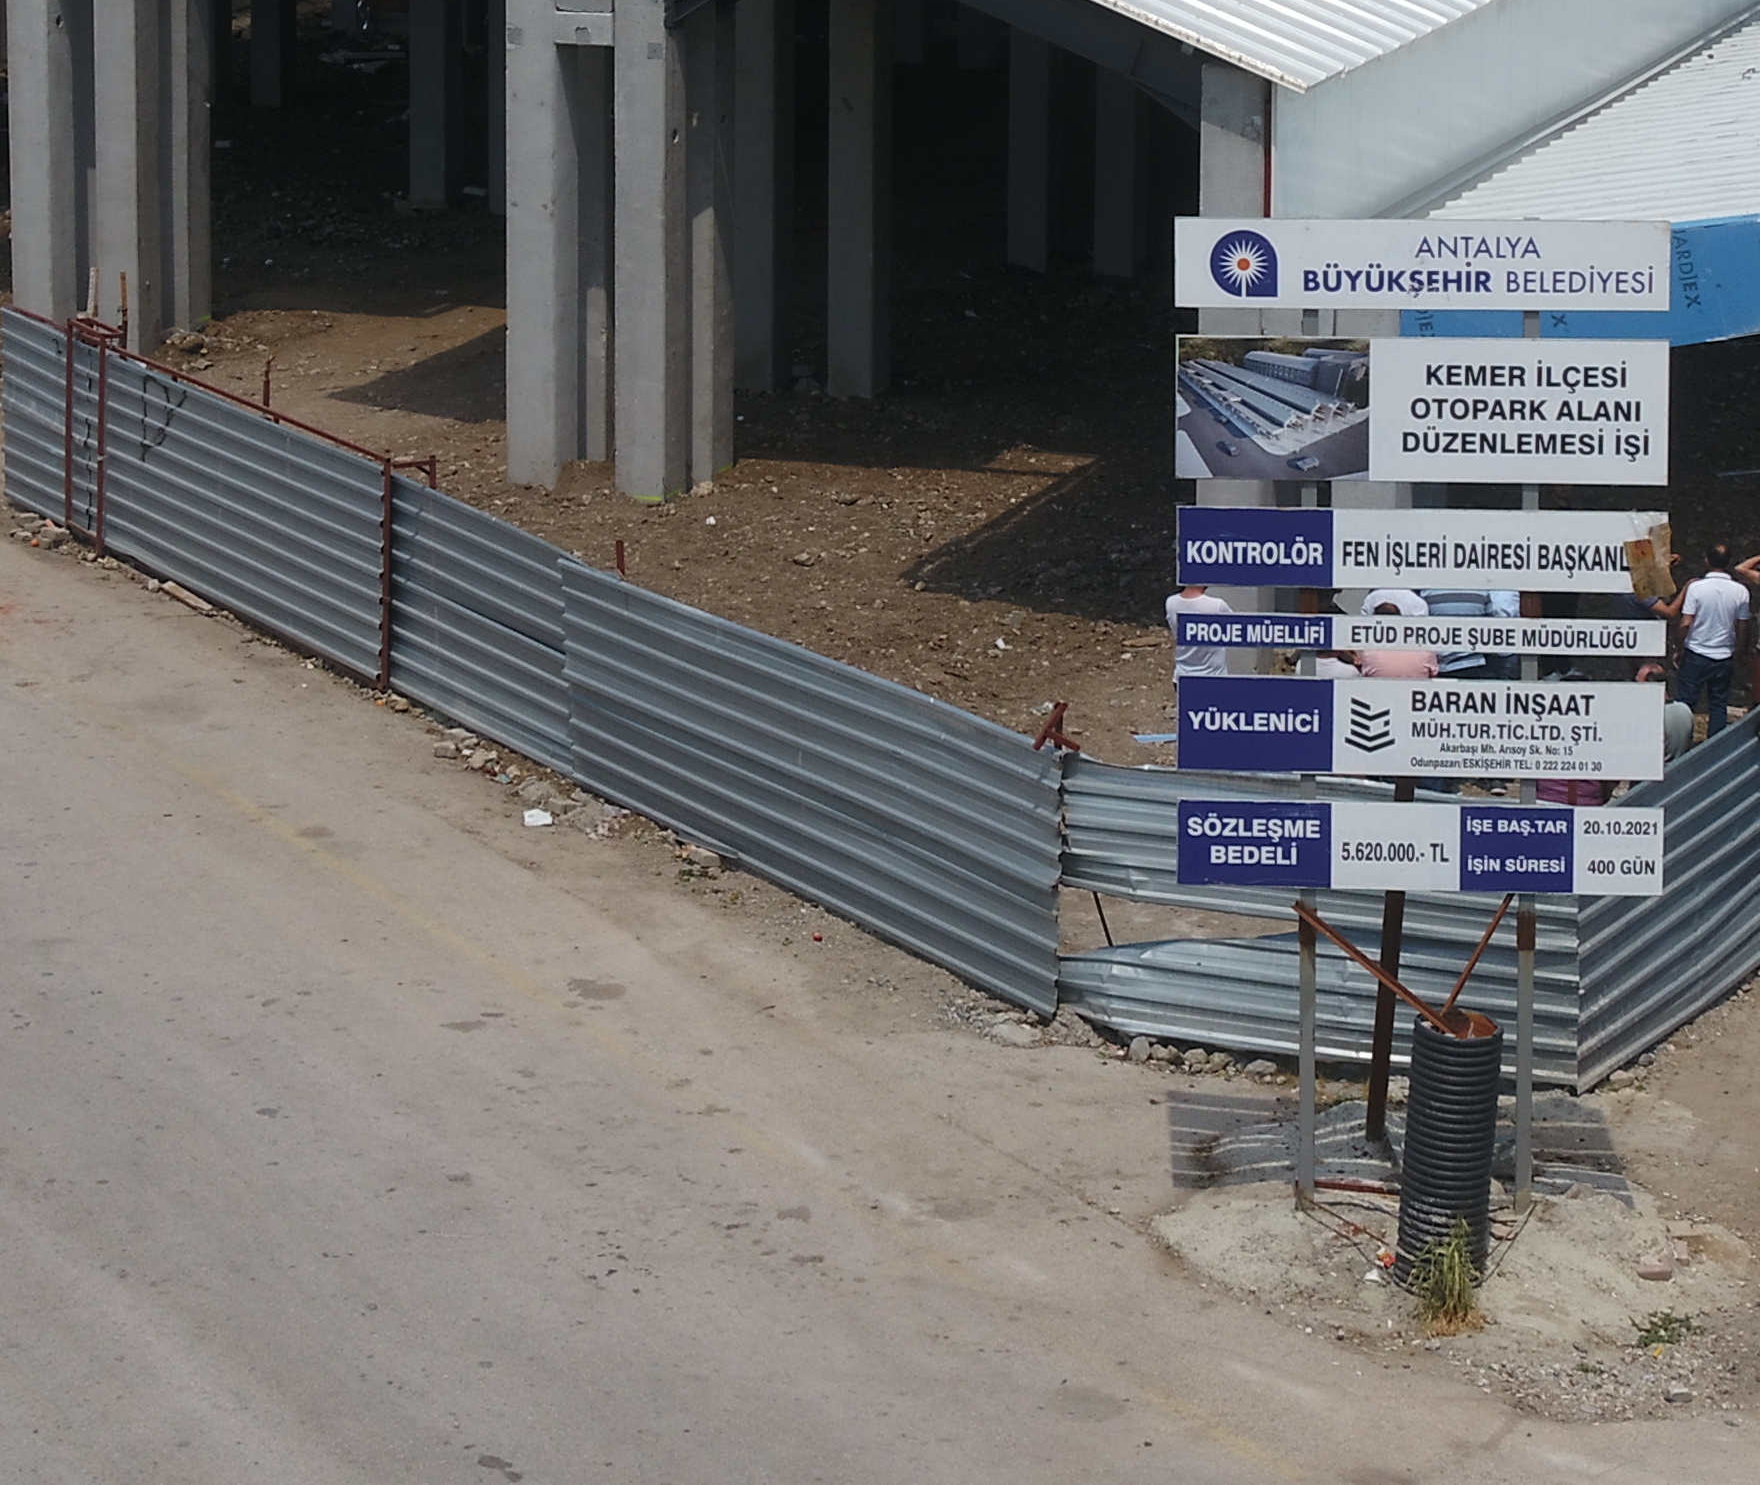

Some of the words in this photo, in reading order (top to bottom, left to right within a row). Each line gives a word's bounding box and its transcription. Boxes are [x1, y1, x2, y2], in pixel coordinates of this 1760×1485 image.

[1415, 235, 1542, 260] ANTALYA
[1302, 262, 1493, 299] BÜYÜKŞEHİR
[1505, 265, 1656, 295] BELEDİYESİ
[1425, 363, 1527, 388] KEMER
[1536, 359, 1629, 395] İLÇESİ
[1410, 398, 1548, 422] OTOPARK
[1555, 400, 1642, 423] ALANI
[1402, 426, 1605, 457] DÜZENLEMESİ
[1614, 432, 1651, 463] İŞİ
[1186, 535, 1324, 567] KONTROLÖR
[1342, 542, 1380, 568] FEN
[1385, 534, 1448, 576] İŞLERİ
[1453, 536, 1532, 571] DAİRESİ
[1538, 543, 1632, 579] BAŞKANL
[1186, 622, 1242, 643] PROJE
[1247, 620, 1325, 646] MÜELLİFİ
[1351, 619, 1397, 645] ETÜD
[1403, 626, 1462, 647] PROJE
[1467, 627, 1516, 652] ŞUBE
[1521, 622, 1639, 650] MÜDÜRLÜĞÜ
[1410, 690, 1497, 716] BARAN
[1505, 686, 1596, 723] İNŞAAT
[1188, 706, 1321, 734] YÜKLENİCİ
[1411, 718, 1565, 742] MÜH.TUR.TİC.LTD.
[1571, 721, 1604, 747] ŞTİ.
[1440, 743, 1479, 756] Akarbaşı
[1480, 744, 1497, 755] Mh.
[1529, 745, 1543, 756] Sk.
[1545, 746, 1560, 756] No:
[1563, 746, 1574, 756] 15
[1535, 761, 1541, 771] 0
[1542, 761, 1559, 771] 222
[1560, 761, 1577, 772] 224
[1578, 761, 1589, 772] 01
[1591, 762, 1602, 772] 30
[1186, 814, 1321, 843] SÖZLEŞME
[1466, 815, 1495, 839] İŞE
[1498, 817, 1568, 840] BAŞ.TAR
[1583, 820, 1658, 837] 20.10.2021
[1210, 841, 1298, 866] BEDELİ
[1341, 841, 1427, 863] 5.620.000.-
[1430, 843, 1450, 863] TL
[1467, 854, 1500, 878] İŞİN
[1504, 853, 1566, 875] SÜRESİ
[1587, 859, 1615, 876] 400
[1620, 855, 1656, 876] GÜN
